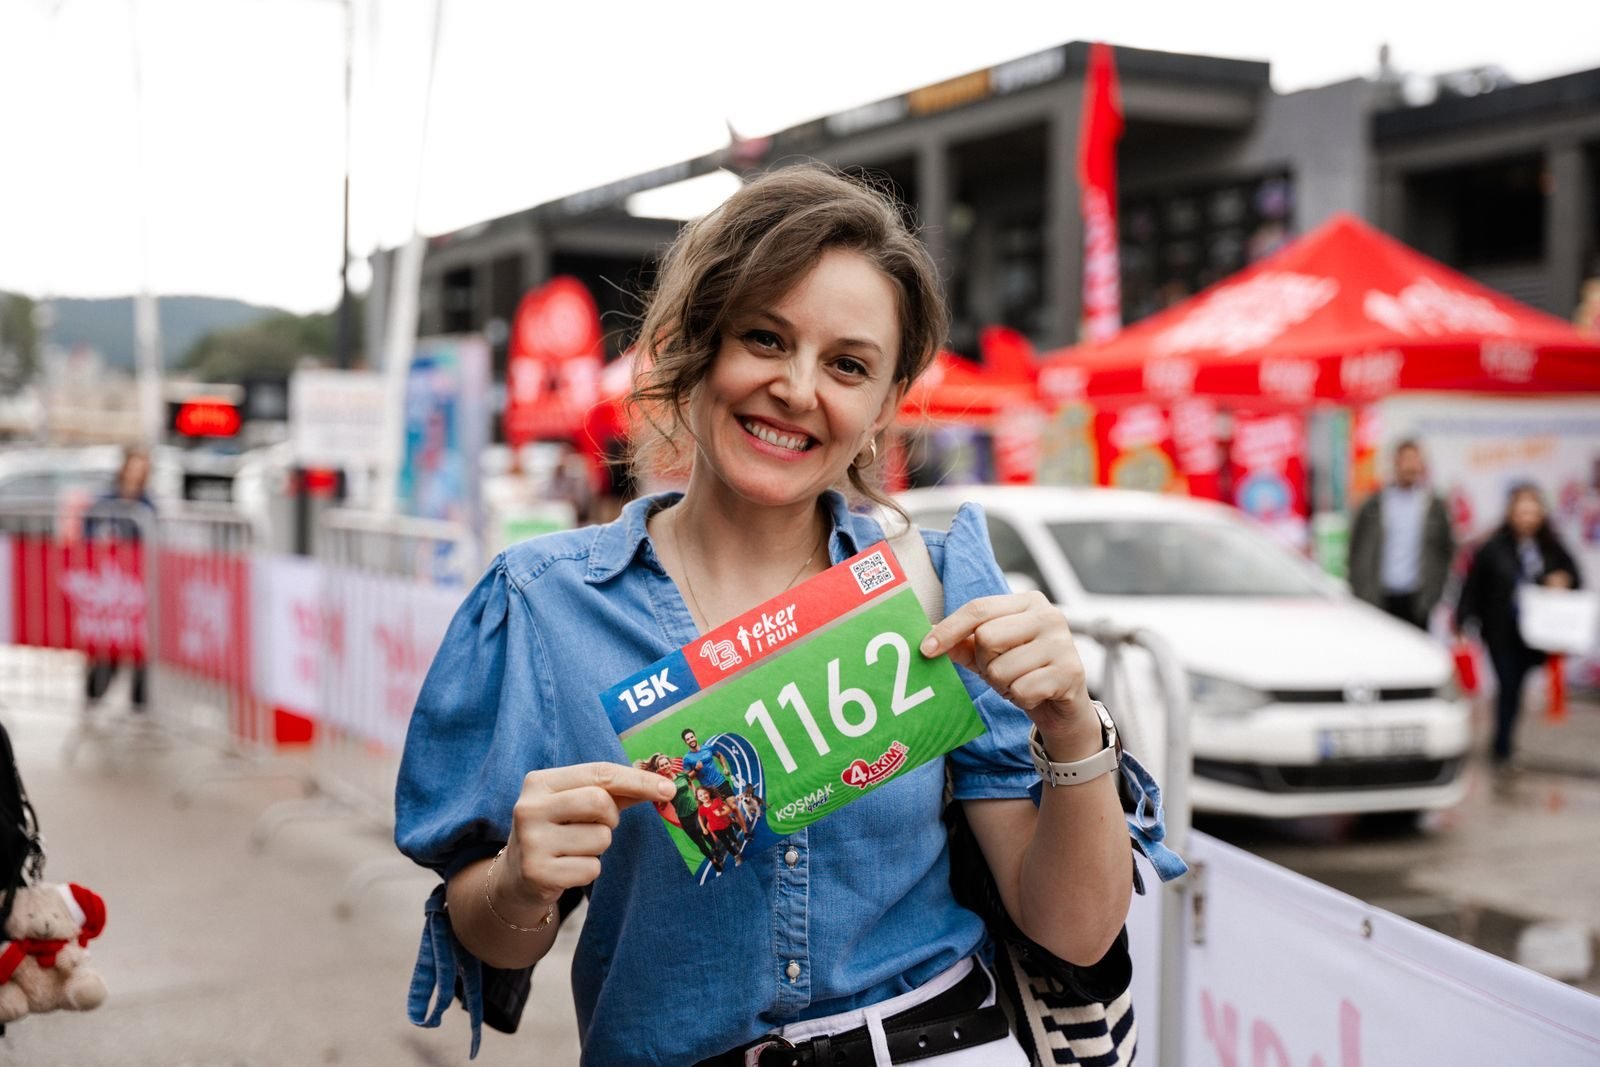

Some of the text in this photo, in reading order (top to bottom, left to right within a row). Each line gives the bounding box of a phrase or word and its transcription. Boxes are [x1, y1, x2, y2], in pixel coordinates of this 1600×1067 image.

[752, 603, 796, 638] eker
[766, 621, 798, 647] RUN
[618, 667, 680, 714] 15K
[744, 631, 936, 774] 1162
[850, 764, 869, 785] 4
